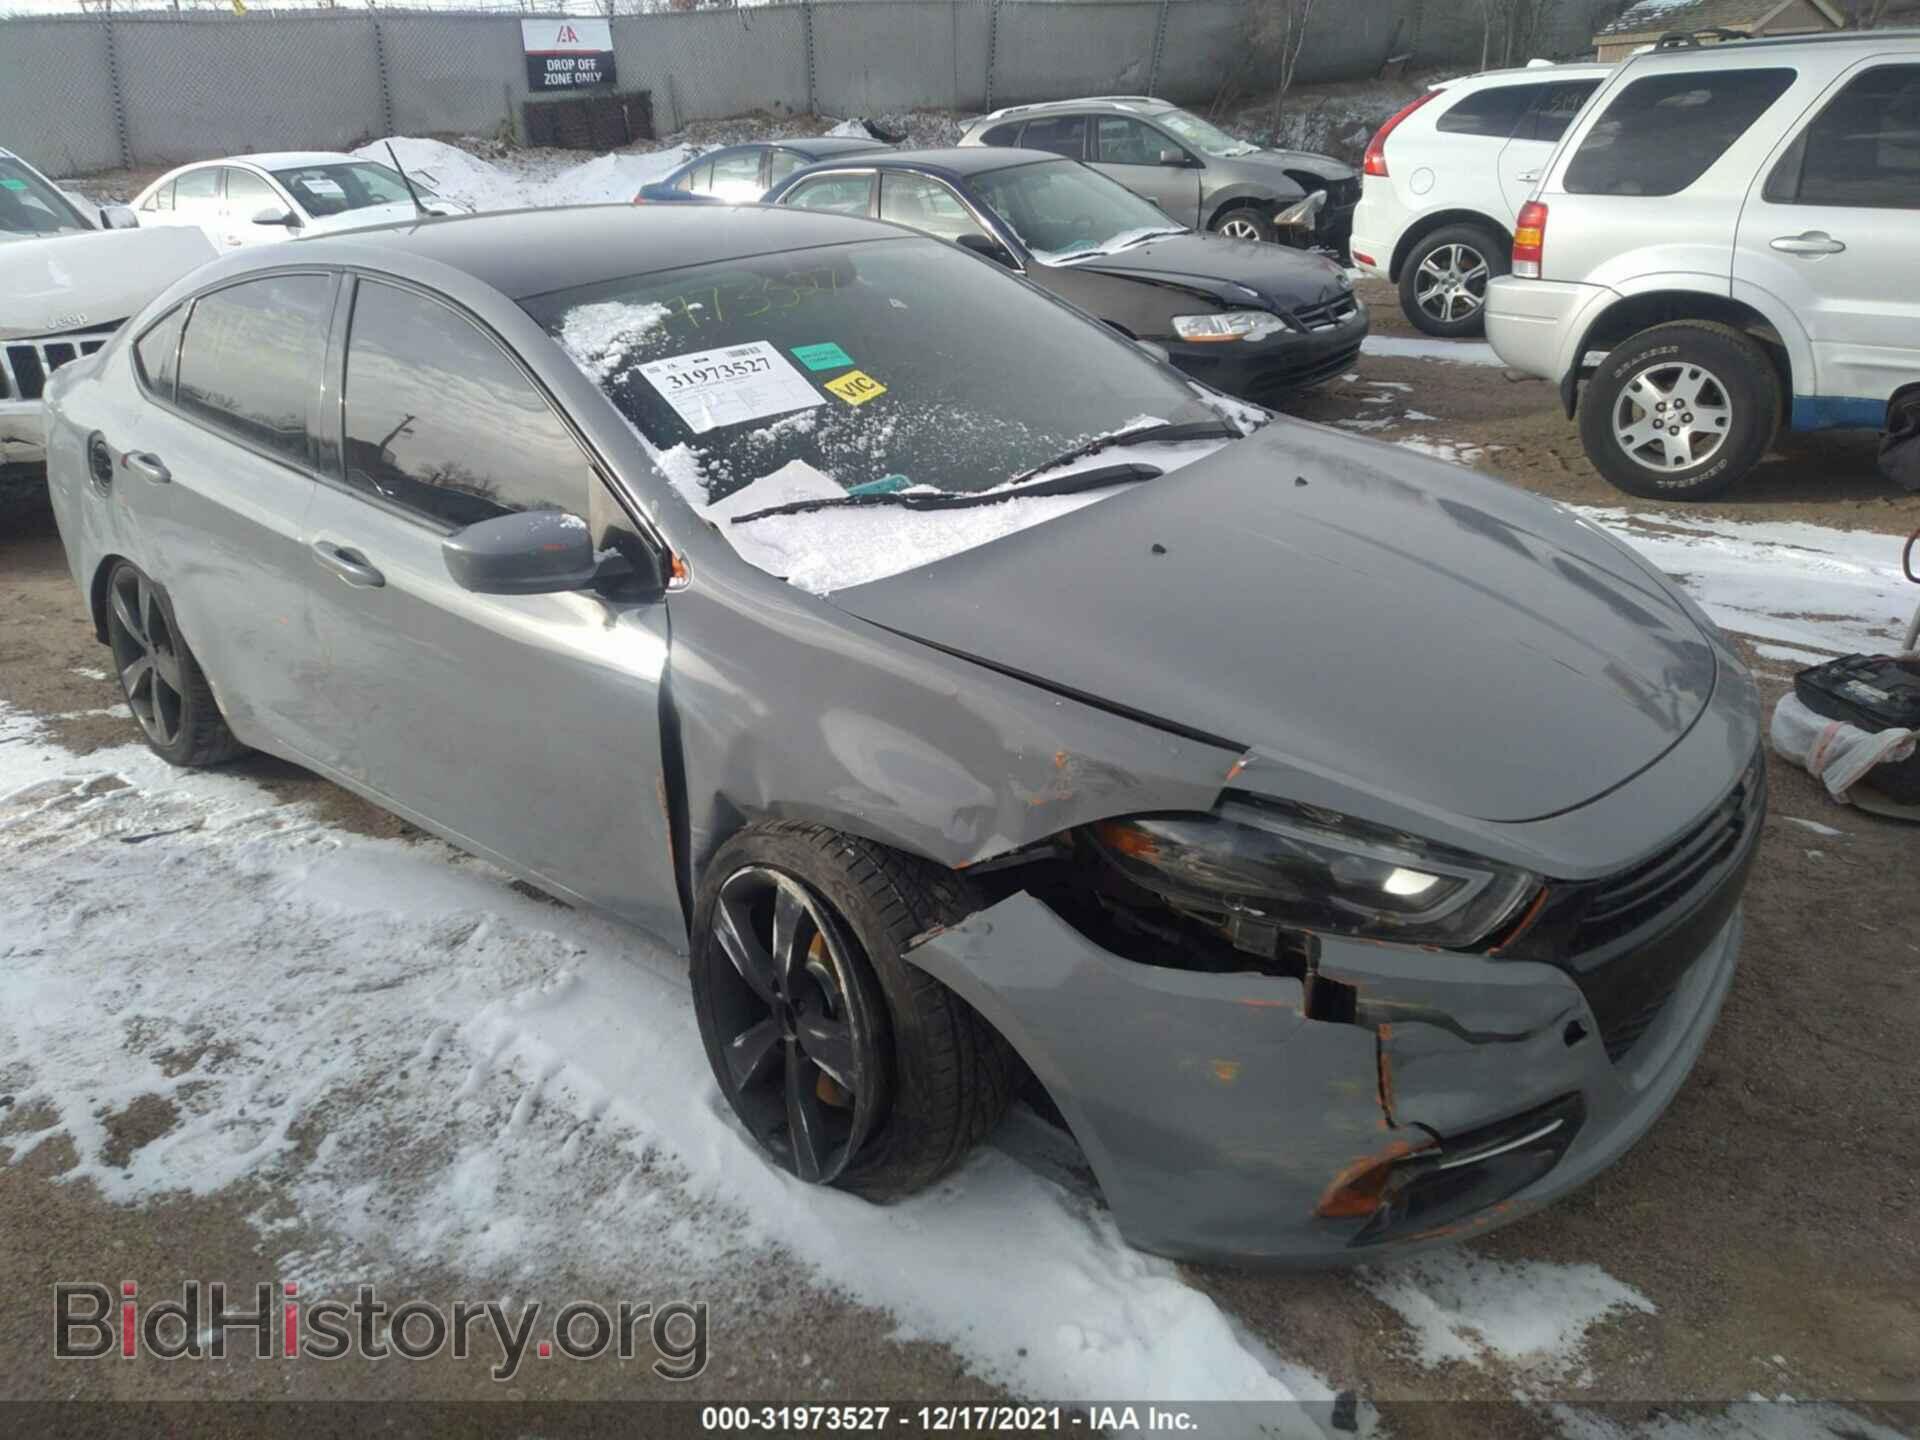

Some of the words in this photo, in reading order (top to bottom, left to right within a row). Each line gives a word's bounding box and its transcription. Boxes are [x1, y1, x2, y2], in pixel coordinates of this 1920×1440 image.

[546, 59, 576, 71] DROP
[578, 58, 597, 70] OFF
[543, 73, 573, 85] ZONE
[575, 72, 602, 83] ONLY
[47, 312, 89, 329] Jeep
[665, 357, 773, 389] 31973527
[834, 376, 876, 398] VIC
